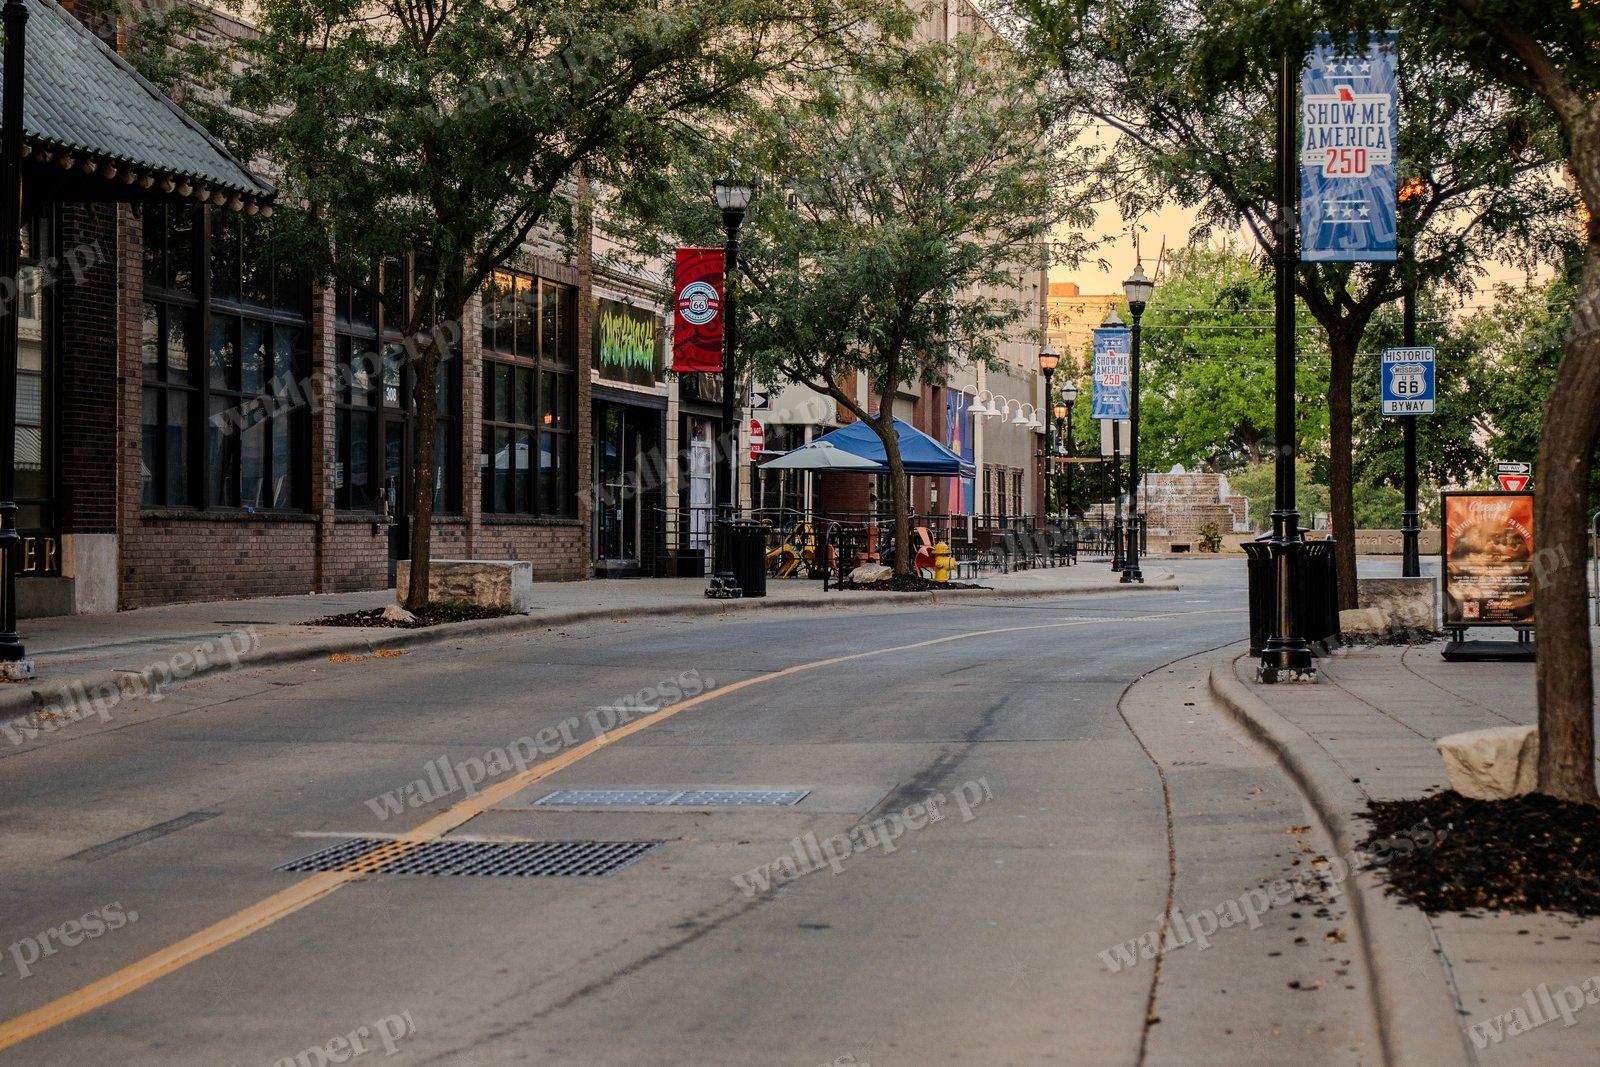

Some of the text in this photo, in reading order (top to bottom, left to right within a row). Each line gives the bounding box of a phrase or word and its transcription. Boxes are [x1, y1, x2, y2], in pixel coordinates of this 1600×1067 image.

[1306, 127, 1387, 151] AMERICA
[1326, 148, 1366, 174] 250
[693, 301, 704, 309] 66
[1385, 350, 1431, 361] HISTORIC
[1096, 365, 1128, 376] AMERICA
[1103, 374, 1120, 385] 250
[1398, 381, 1418, 393] 66
[1391, 401, 1425, 411] BYWAY
